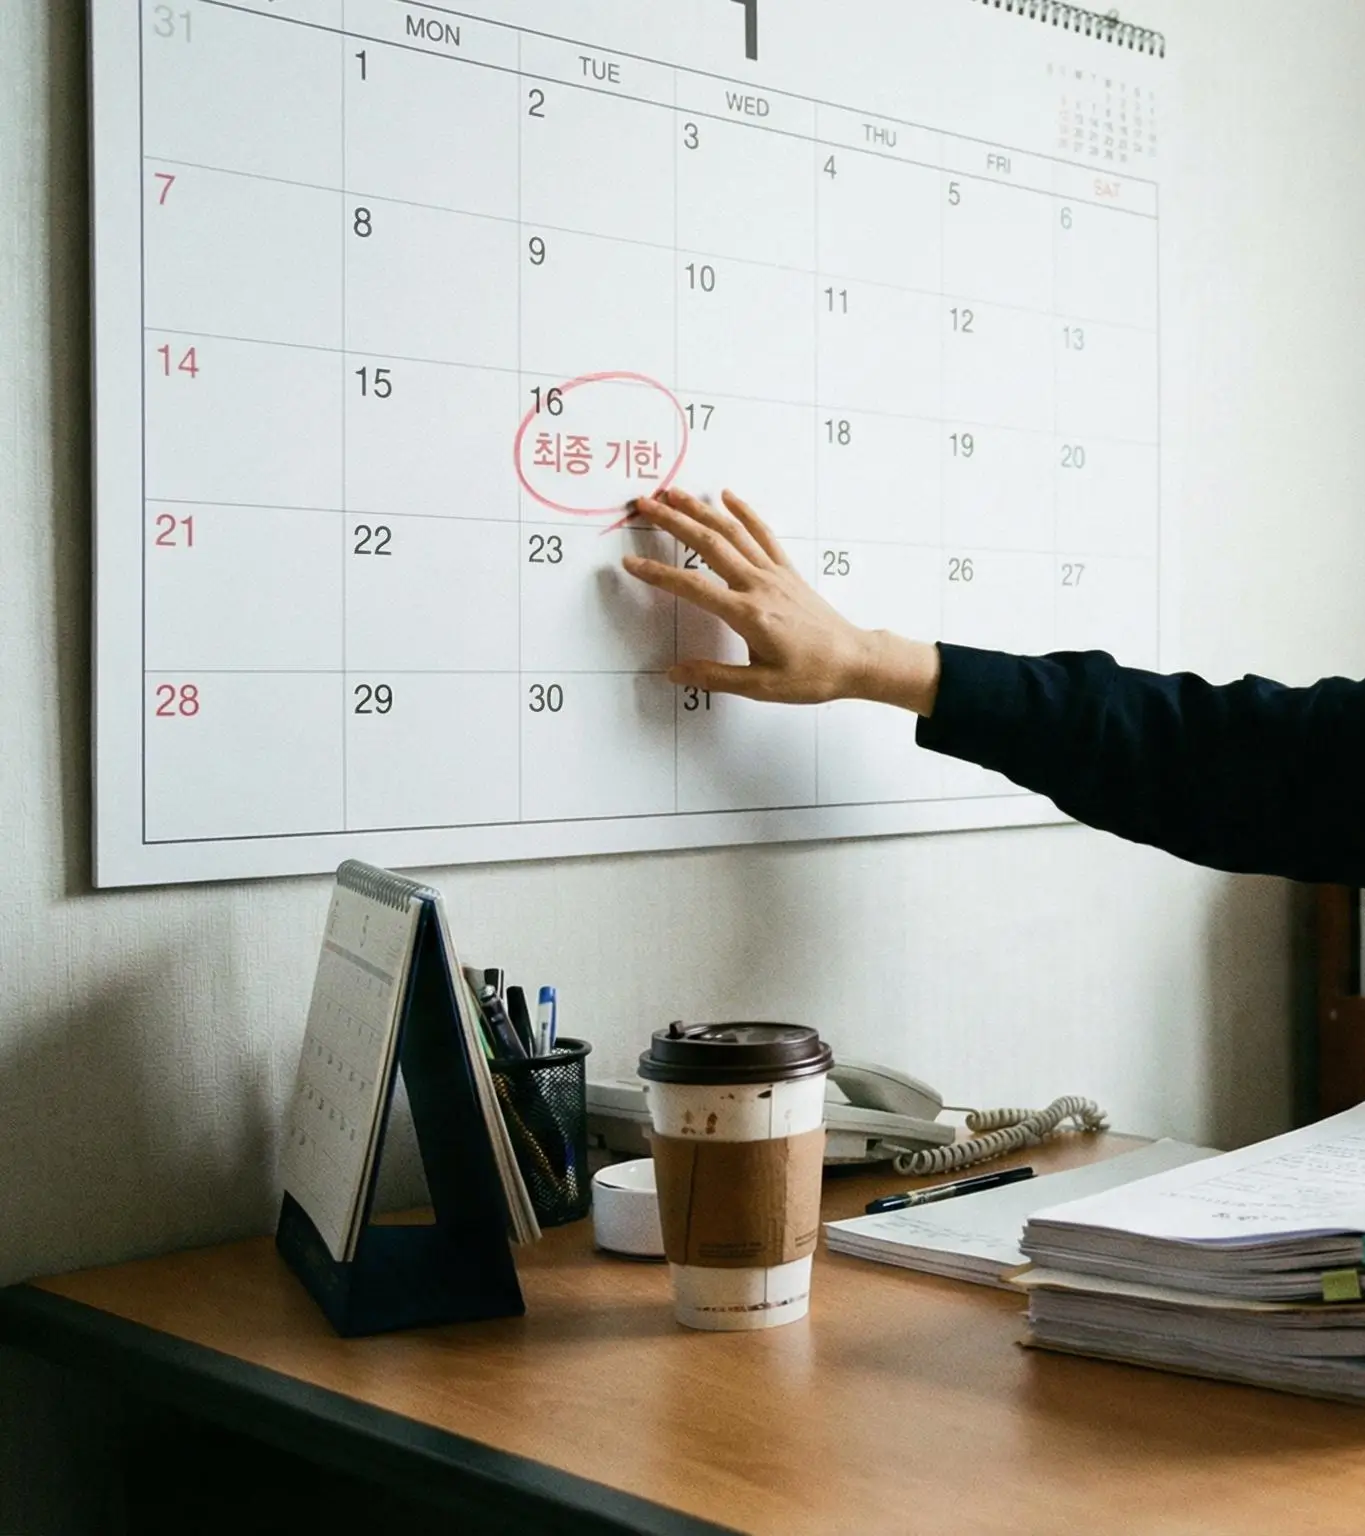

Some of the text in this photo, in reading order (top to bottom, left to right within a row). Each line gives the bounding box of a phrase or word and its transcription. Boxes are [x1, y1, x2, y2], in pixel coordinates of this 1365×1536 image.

[154, 5, 1072, 229] 31 1 2 3 4 5 6
[406, 14, 1121, 198] MON TUE WED THU FRI SAT
[155, 173, 1084, 350] 7 8 9 10 11 12 13
[158, 344, 1085, 469] 14 15 16 17 18 19 20
[534, 433, 661, 479] 최종 기한
[156, 514, 192, 547] 21
[354, 525, 391, 555] 22
[529, 535, 563, 563] 23
[824, 551, 849, 576] 25
[949, 558, 973, 581] 26
[1062, 564, 1085, 586] 27
[156, 684, 711, 716] 28 29 30 31
